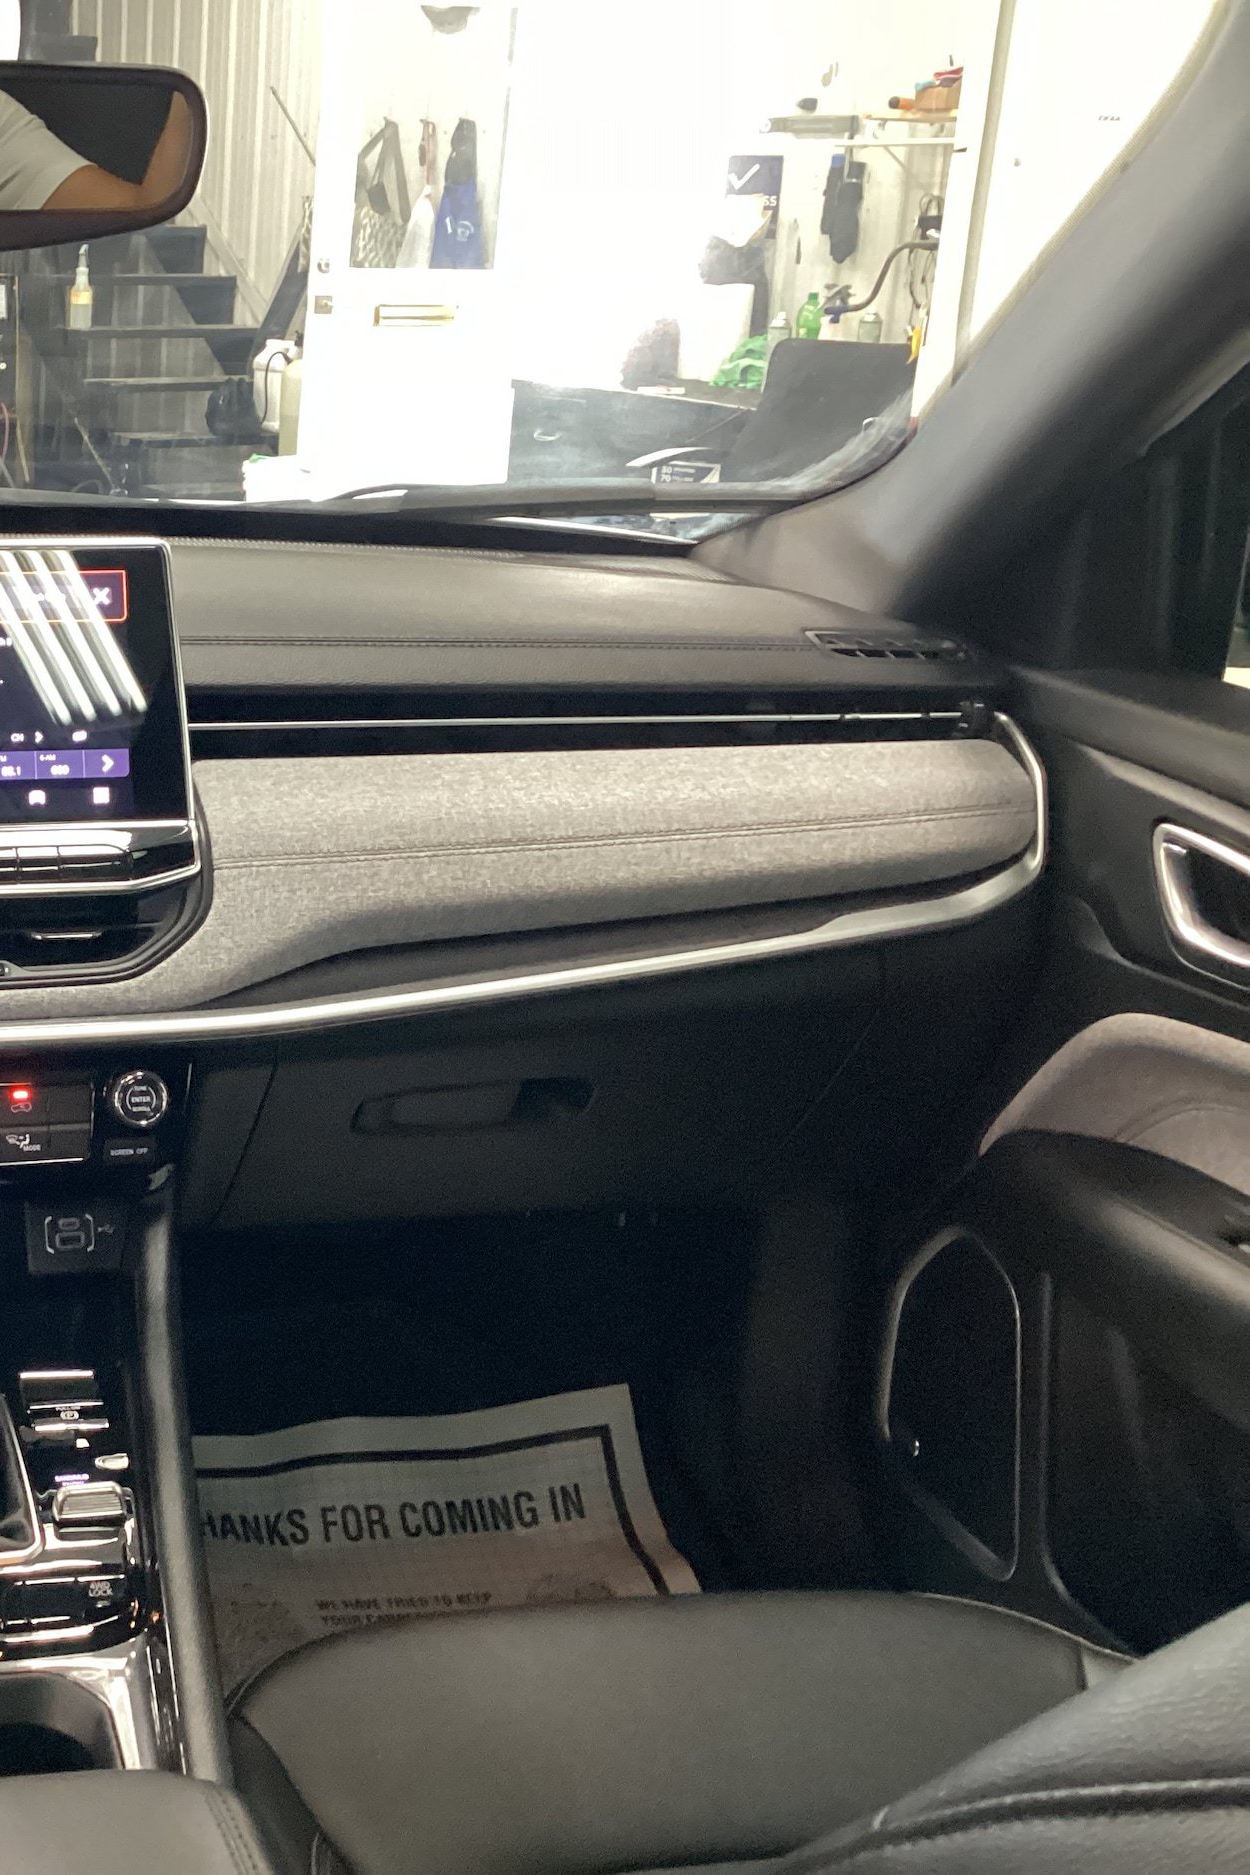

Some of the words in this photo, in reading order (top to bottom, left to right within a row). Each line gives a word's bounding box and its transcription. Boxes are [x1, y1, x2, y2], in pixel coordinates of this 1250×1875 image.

[23, 1144, 41, 1152] MODE
[199, 1508, 310, 1546] HANKS
[320, 1503, 390, 1543] FOR
[399, 1490, 539, 1538] COMING
[548, 1483, 587, 1522] IN
[88, 1588, 114, 1597] LOCK
